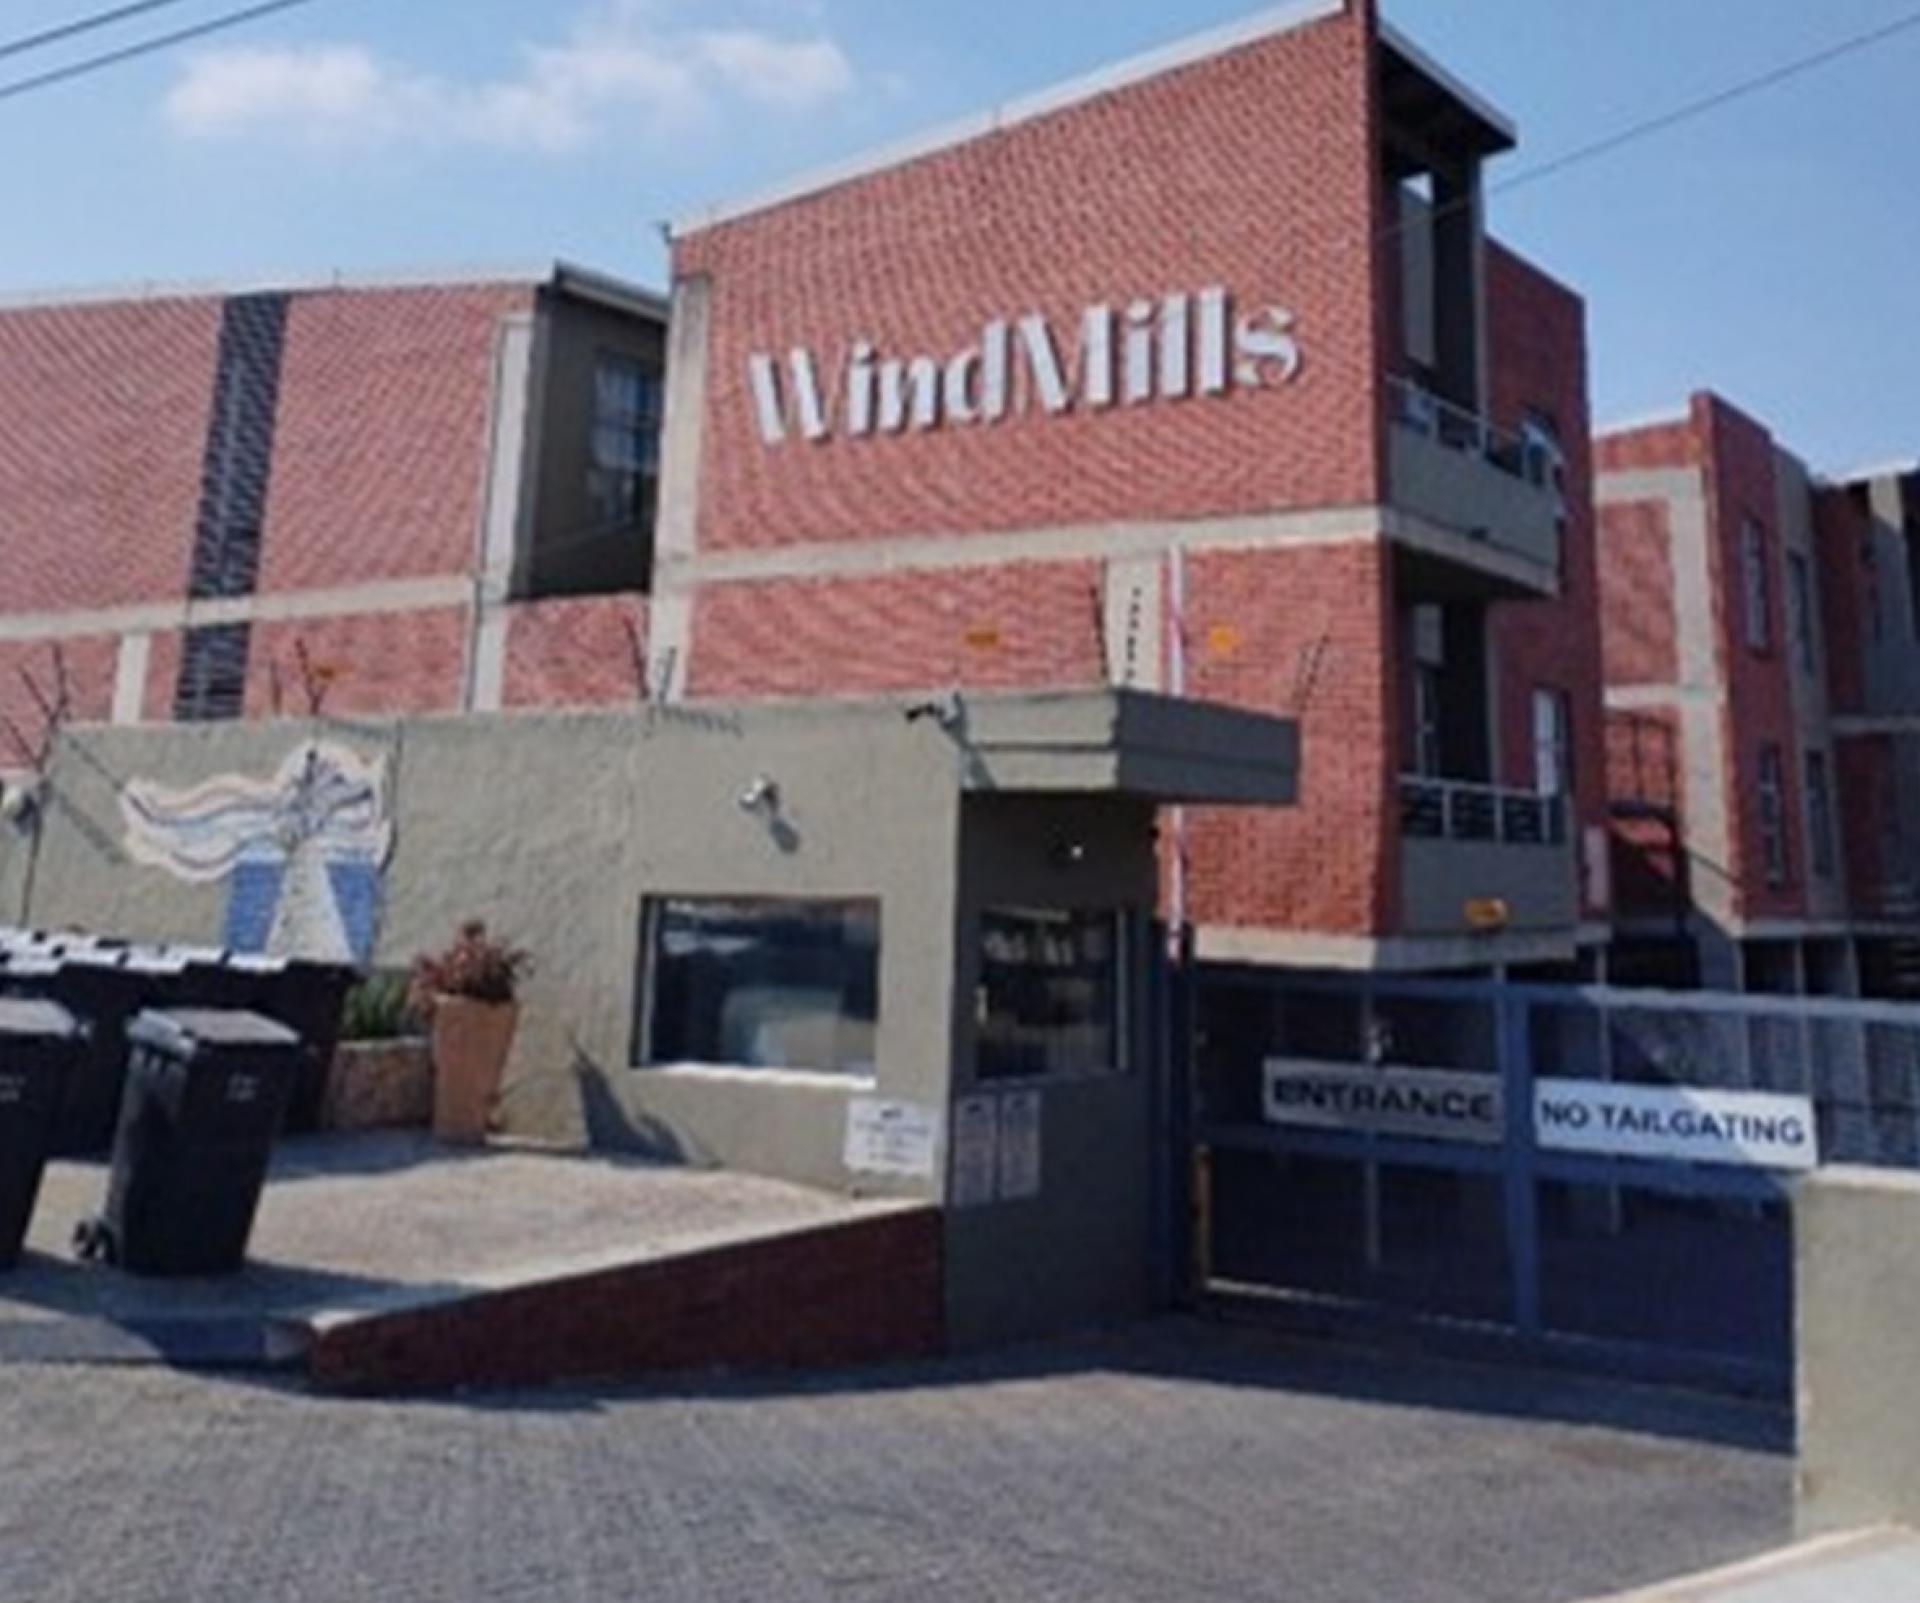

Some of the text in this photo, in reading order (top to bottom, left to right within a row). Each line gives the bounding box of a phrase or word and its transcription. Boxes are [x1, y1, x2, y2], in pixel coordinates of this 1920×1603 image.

[748, 285, 1301, 444] WindMills
[1273, 1077, 1494, 1124] ENTRANCE
[1541, 1101, 1805, 1146] NO TAILGATING
